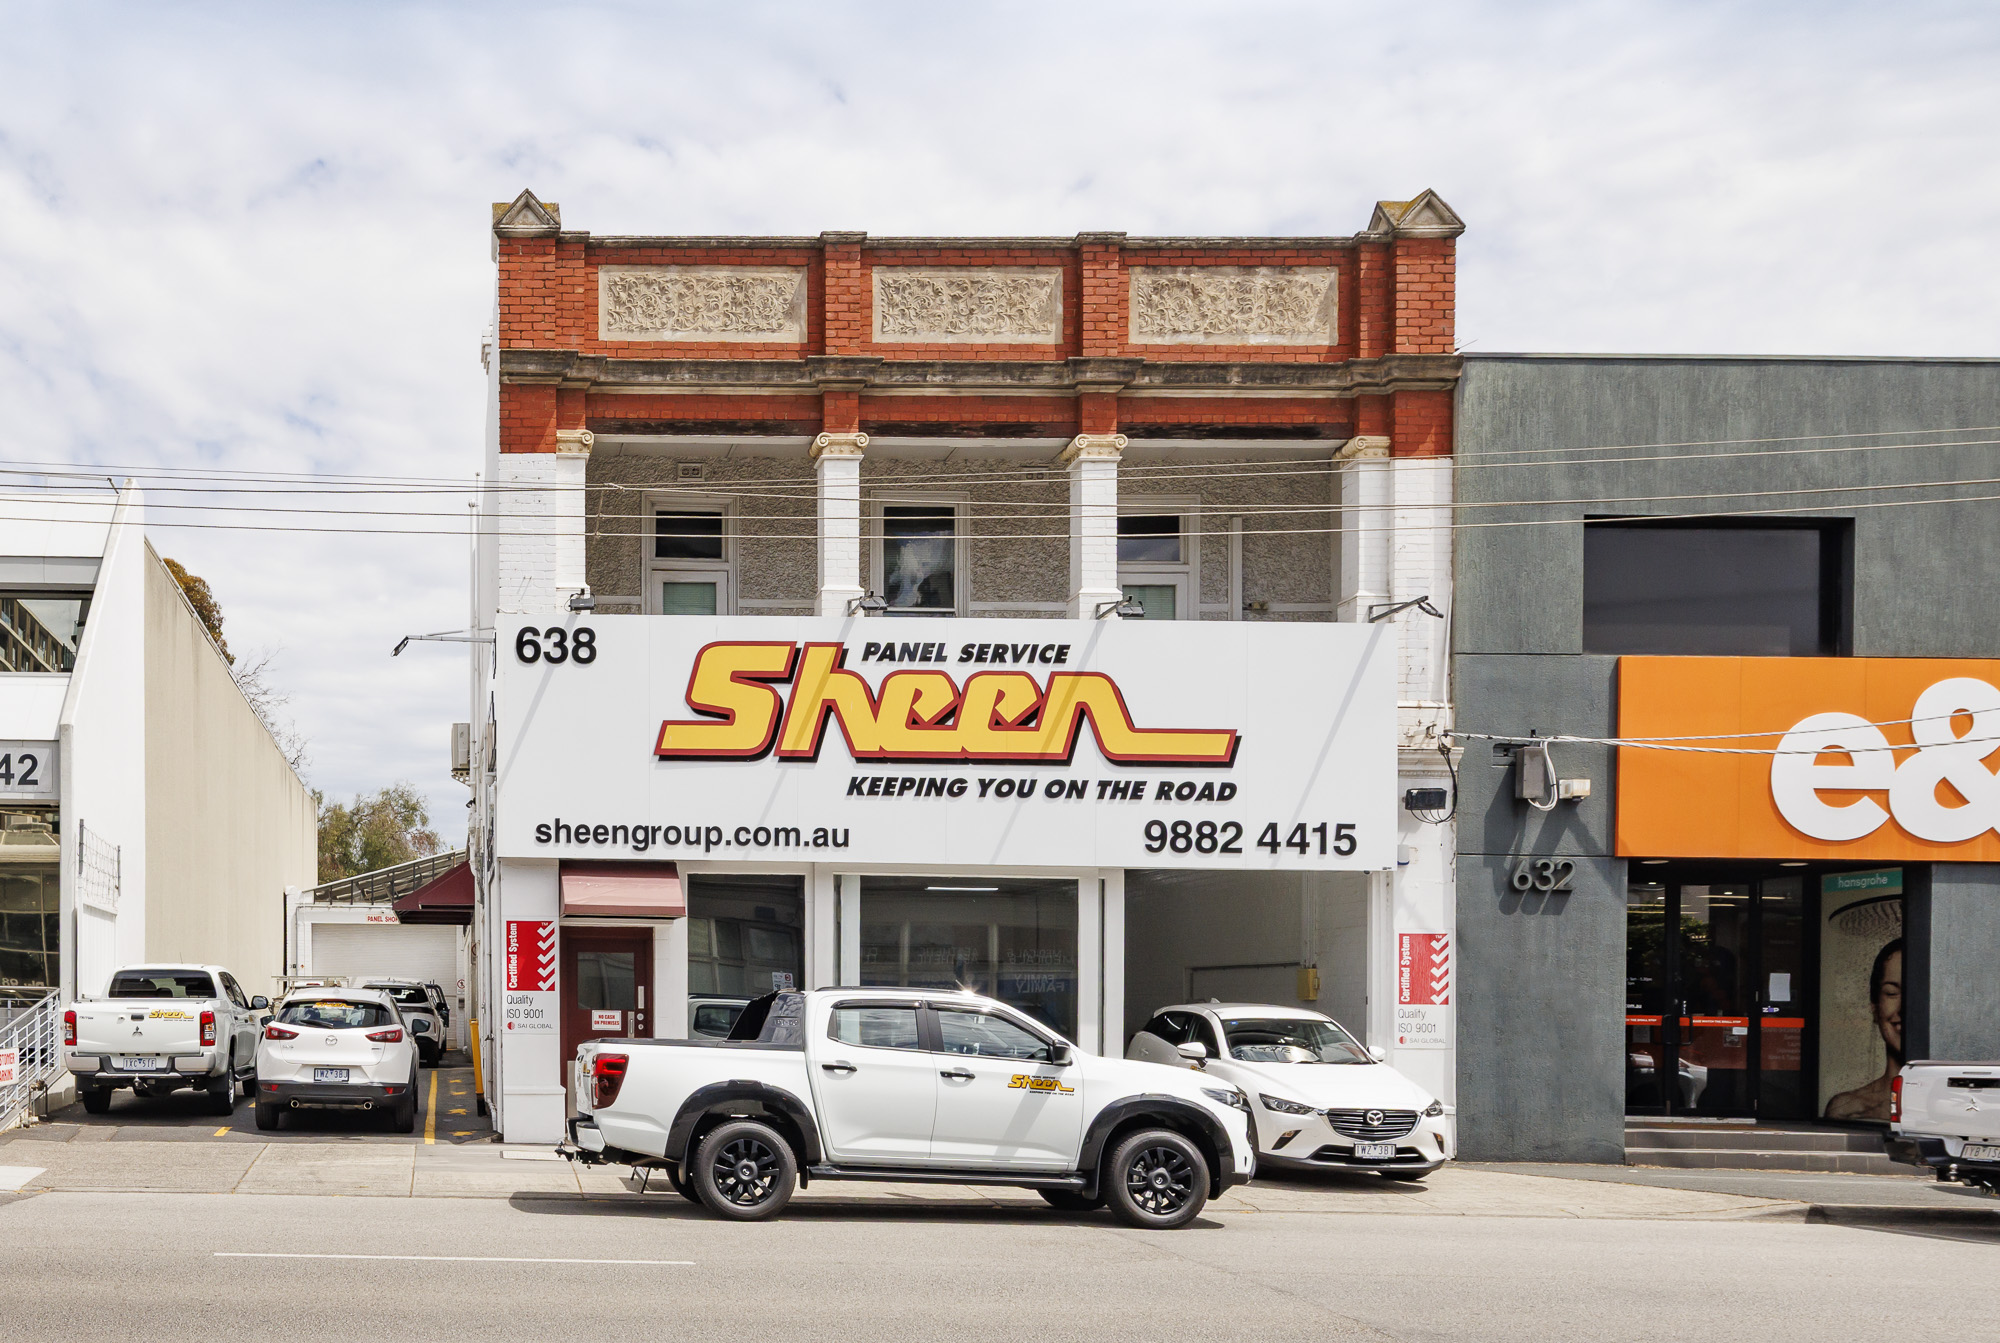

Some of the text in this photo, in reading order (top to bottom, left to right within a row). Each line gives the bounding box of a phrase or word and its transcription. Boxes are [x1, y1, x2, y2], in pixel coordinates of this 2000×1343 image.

[516, 627, 597, 664] 638
[862, 642, 1071, 664] PANEL SERVICE
[654, 641, 1242, 767] Sheen
[0, 754, 38, 785] 42
[847, 776, 1237, 802] KEEPING YOU ON THE ROAD
[535, 818, 850, 852] sheengroup.com.au
[1144, 820, 1357, 856] 9882 4415
[1513, 859, 1576, 890] 632
[1838, 873, 1888, 888] hansgrohe
[508, 923, 519, 989] Certified System
[1400, 936, 1412, 1002] Certified System
[506, 995, 534, 1006] Quality
[149, 1009, 194, 1019] Sheen
[506, 1009, 544, 1019] ISO 9001
[1398, 1009, 1426, 1020] Quality
[1398, 1023, 1436, 1033] ISO 9001
[1008, 1074, 1074, 1092] Sheen
